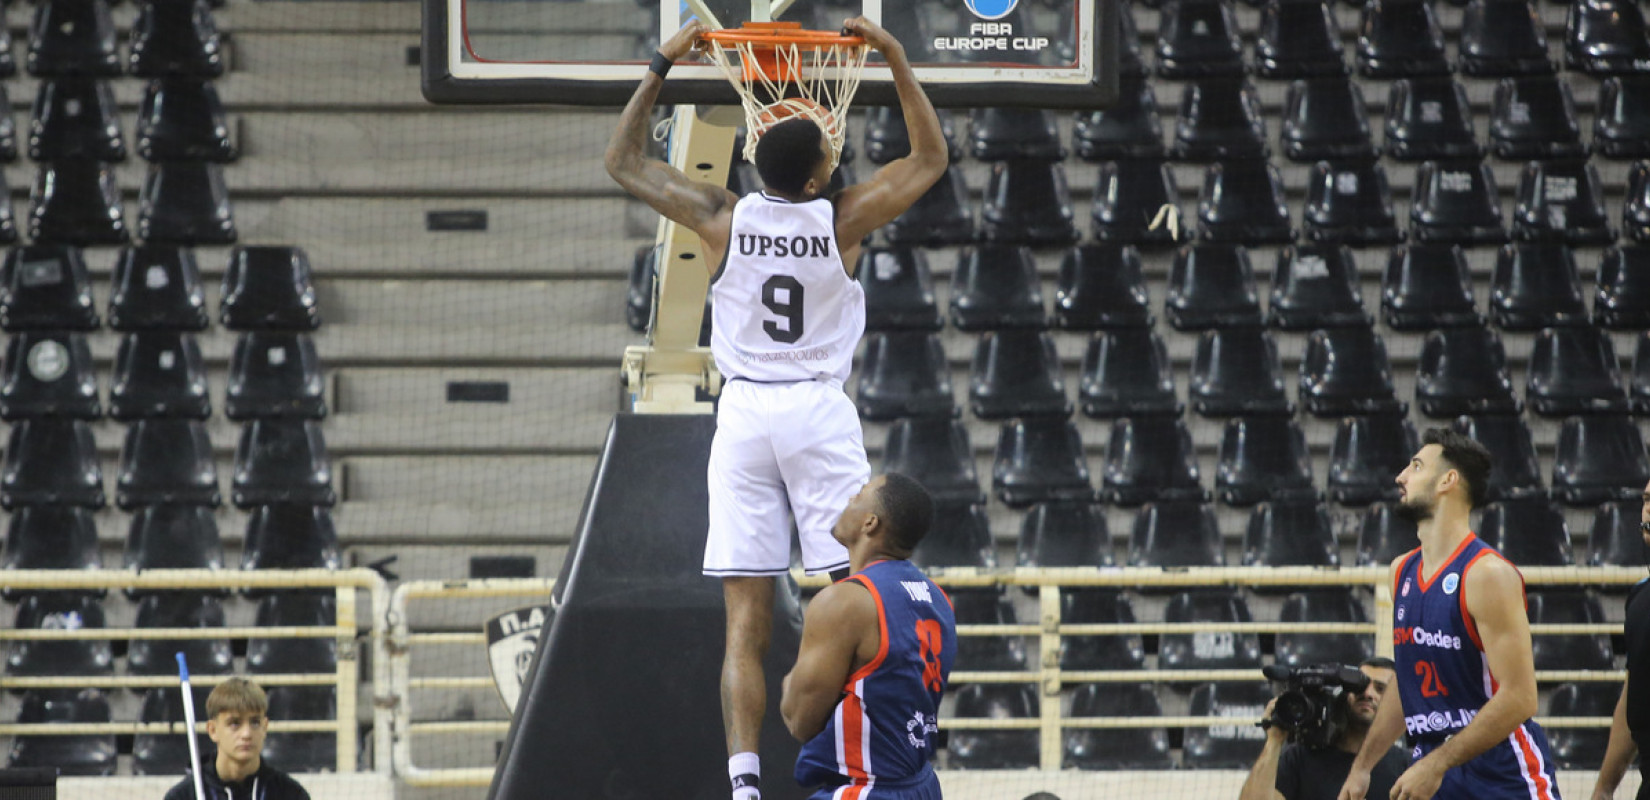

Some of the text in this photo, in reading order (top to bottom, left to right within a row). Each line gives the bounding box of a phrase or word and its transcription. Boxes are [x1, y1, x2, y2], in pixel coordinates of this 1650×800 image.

[970, 22, 1012, 36] FIBA
[934, 37, 1049, 50] EUROPE CUP
[738, 233, 830, 258] UPSON
[761, 274, 804, 344] 9
